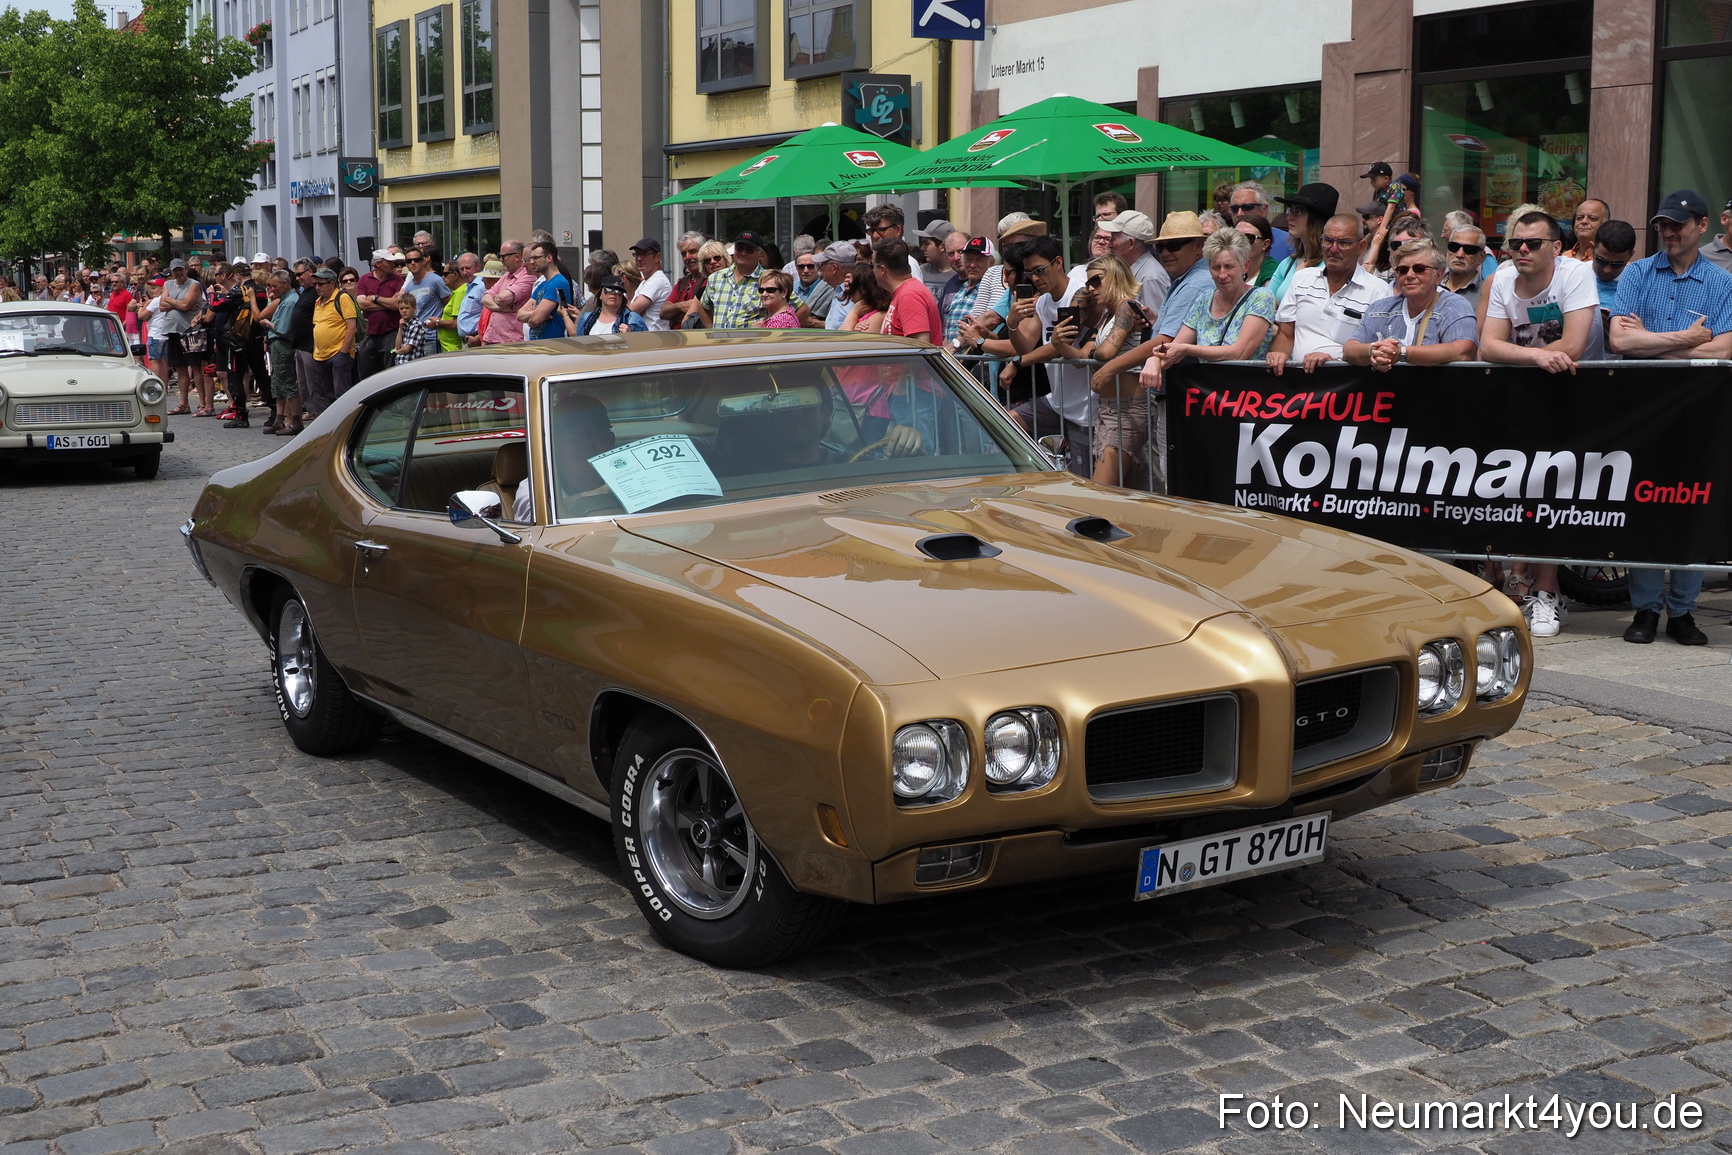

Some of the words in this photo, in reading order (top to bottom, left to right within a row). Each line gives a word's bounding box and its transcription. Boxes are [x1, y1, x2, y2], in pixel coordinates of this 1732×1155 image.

[991, 64, 1015, 78] Unterer
[1016, 59, 1035, 74] Markt
[1037, 56, 1044, 71] 15
[871, 94, 895, 125] G2
[932, 153, 996, 165] Neumarkter
[1098, 152, 1211, 166] Lammsbräu
[1103, 145, 1182, 155] Neumarkter
[1546, 142, 1583, 155] Grillen
[353, 168, 366, 184] G2
[1185, 388, 1395, 423] FAHRSCHULE
[54, 437, 70, 447] AS
[79, 436, 87, 447] T
[87, 436, 108, 446] 601
[647, 444, 685, 462] 292
[1235, 422, 1632, 501] Kohlmann
[1634, 480, 1711, 504] GmbH
[1234, 489, 1310, 512] Neumarkt
[1322, 494, 1420, 520] Burgthann
[1432, 501, 1523, 525] Freystadt
[1535, 503, 1626, 529] Pyrbaum
[272, 667, 290, 720] RADIAL
[1296, 707, 1349, 727] GTO
[621, 753, 645, 828] COBRA
[1157, 850, 1179, 886] N
[1200, 837, 1240, 876] GT
[1247, 818, 1326, 866] 870H
[624, 836, 673, 922] COOPER
